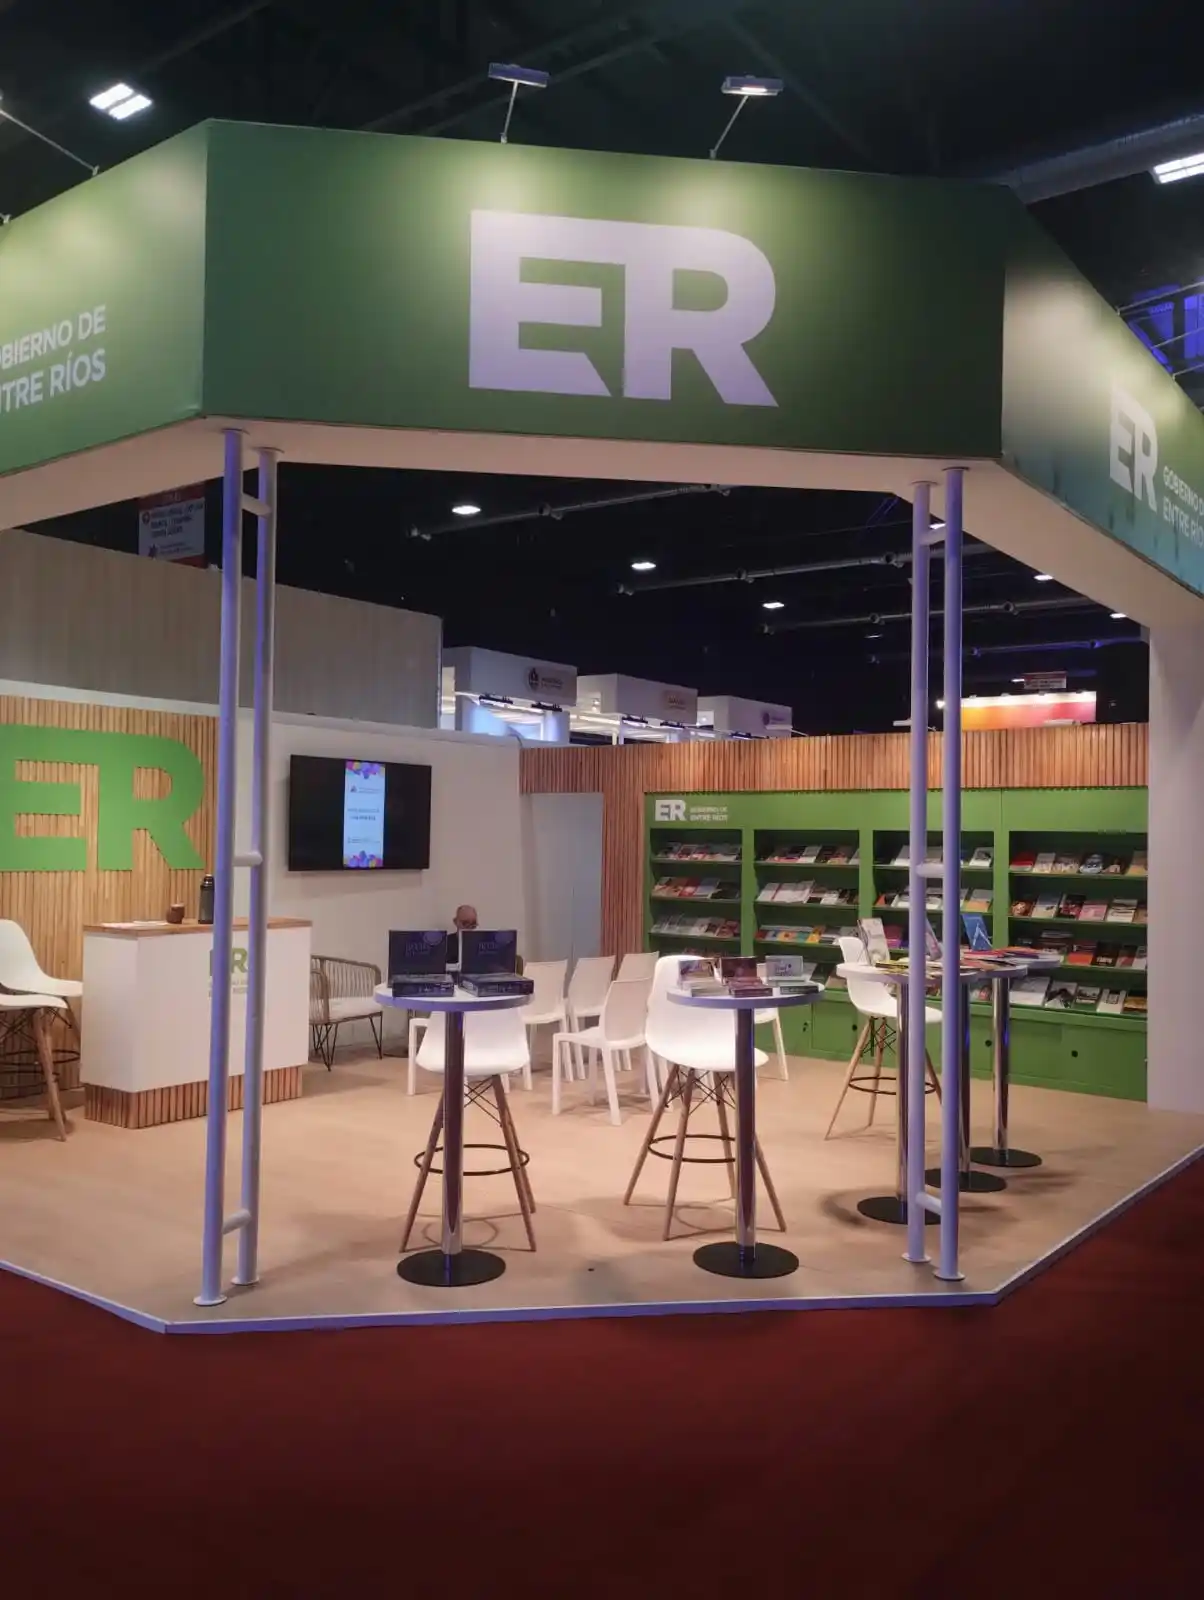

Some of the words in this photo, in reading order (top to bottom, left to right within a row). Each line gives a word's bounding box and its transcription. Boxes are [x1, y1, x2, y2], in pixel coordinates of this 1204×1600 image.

[0, 319, 73, 370] BIERNO
[78, 304, 106, 340] DE
[469, 209, 779, 407] ER
[0, 371, 44, 412] TRE
[50, 349, 106, 398] RÍOS
[1110, 385, 1158, 514] ER
[1163, 496, 1190, 537] ENTRE
[1191, 515, 1204, 548] RÍO
[1199, 497, 1204, 516] D
[0, 724, 206, 871] ER
[655, 800, 687, 821] ER
[209, 948, 248, 976] R
